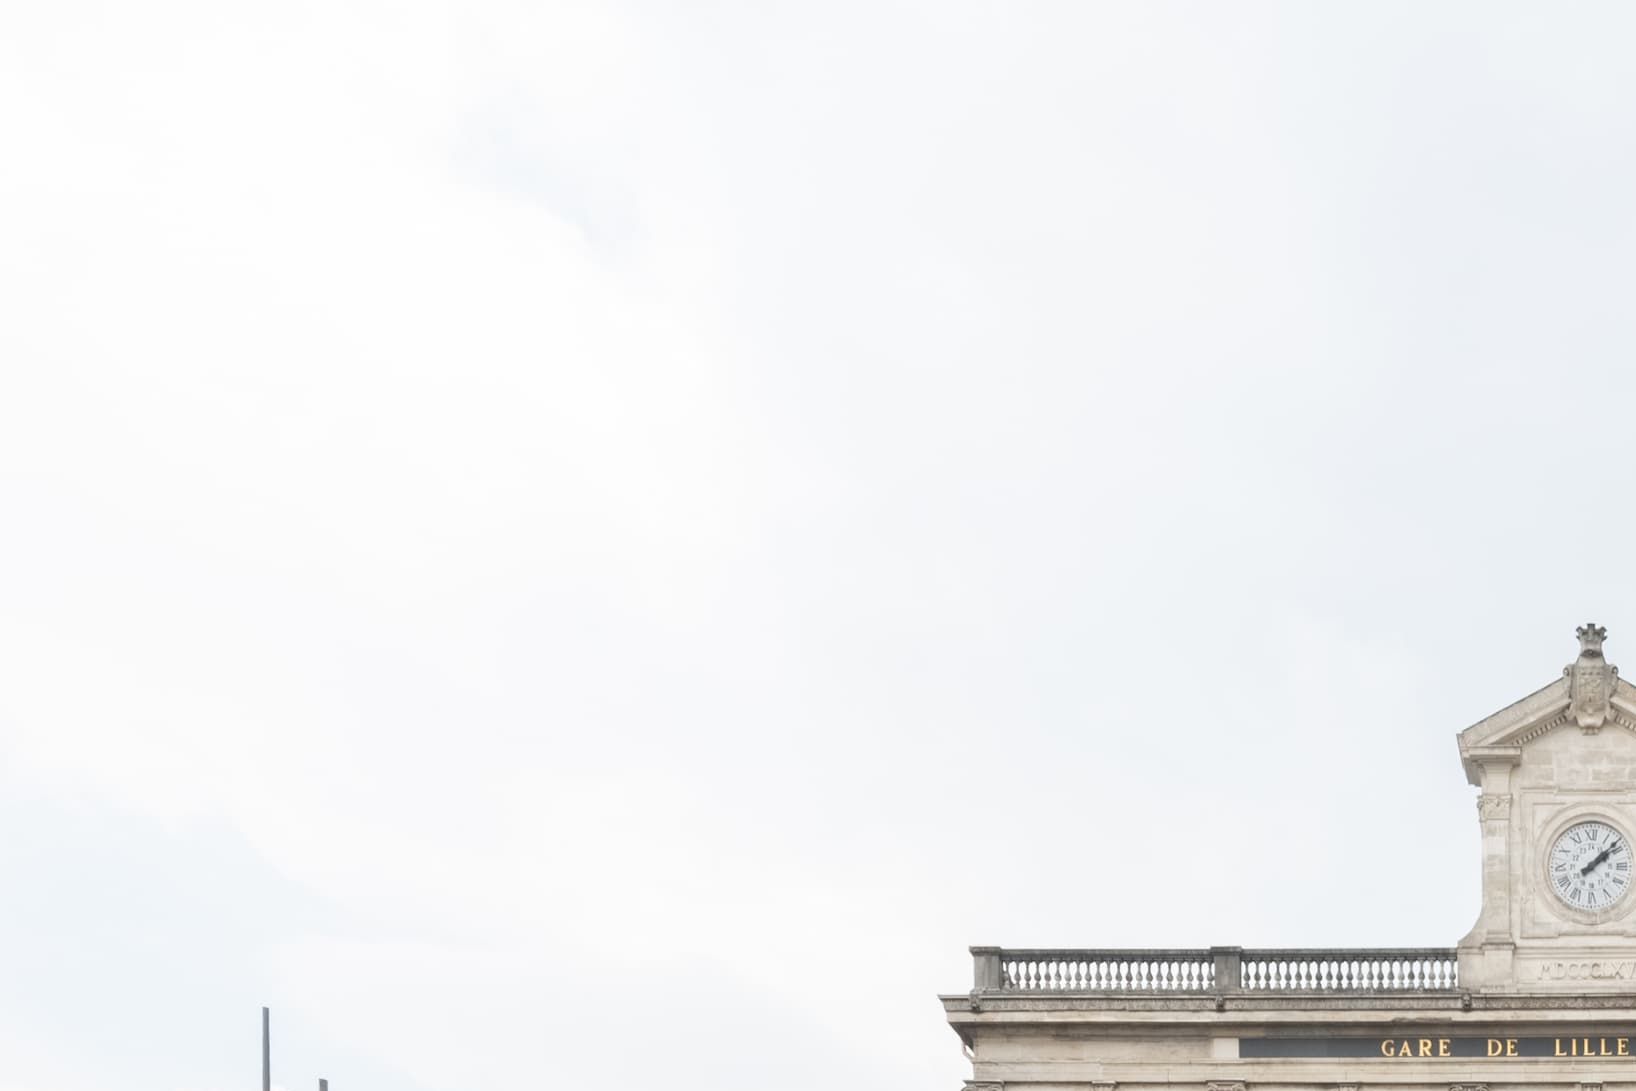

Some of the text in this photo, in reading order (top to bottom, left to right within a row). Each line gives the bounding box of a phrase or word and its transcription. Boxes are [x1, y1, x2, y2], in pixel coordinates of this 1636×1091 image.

[1381, 1038, 1451, 1057] GARE
[1487, 1038, 1519, 1057] DE
[1554, 1038, 1630, 1056] LILLE
